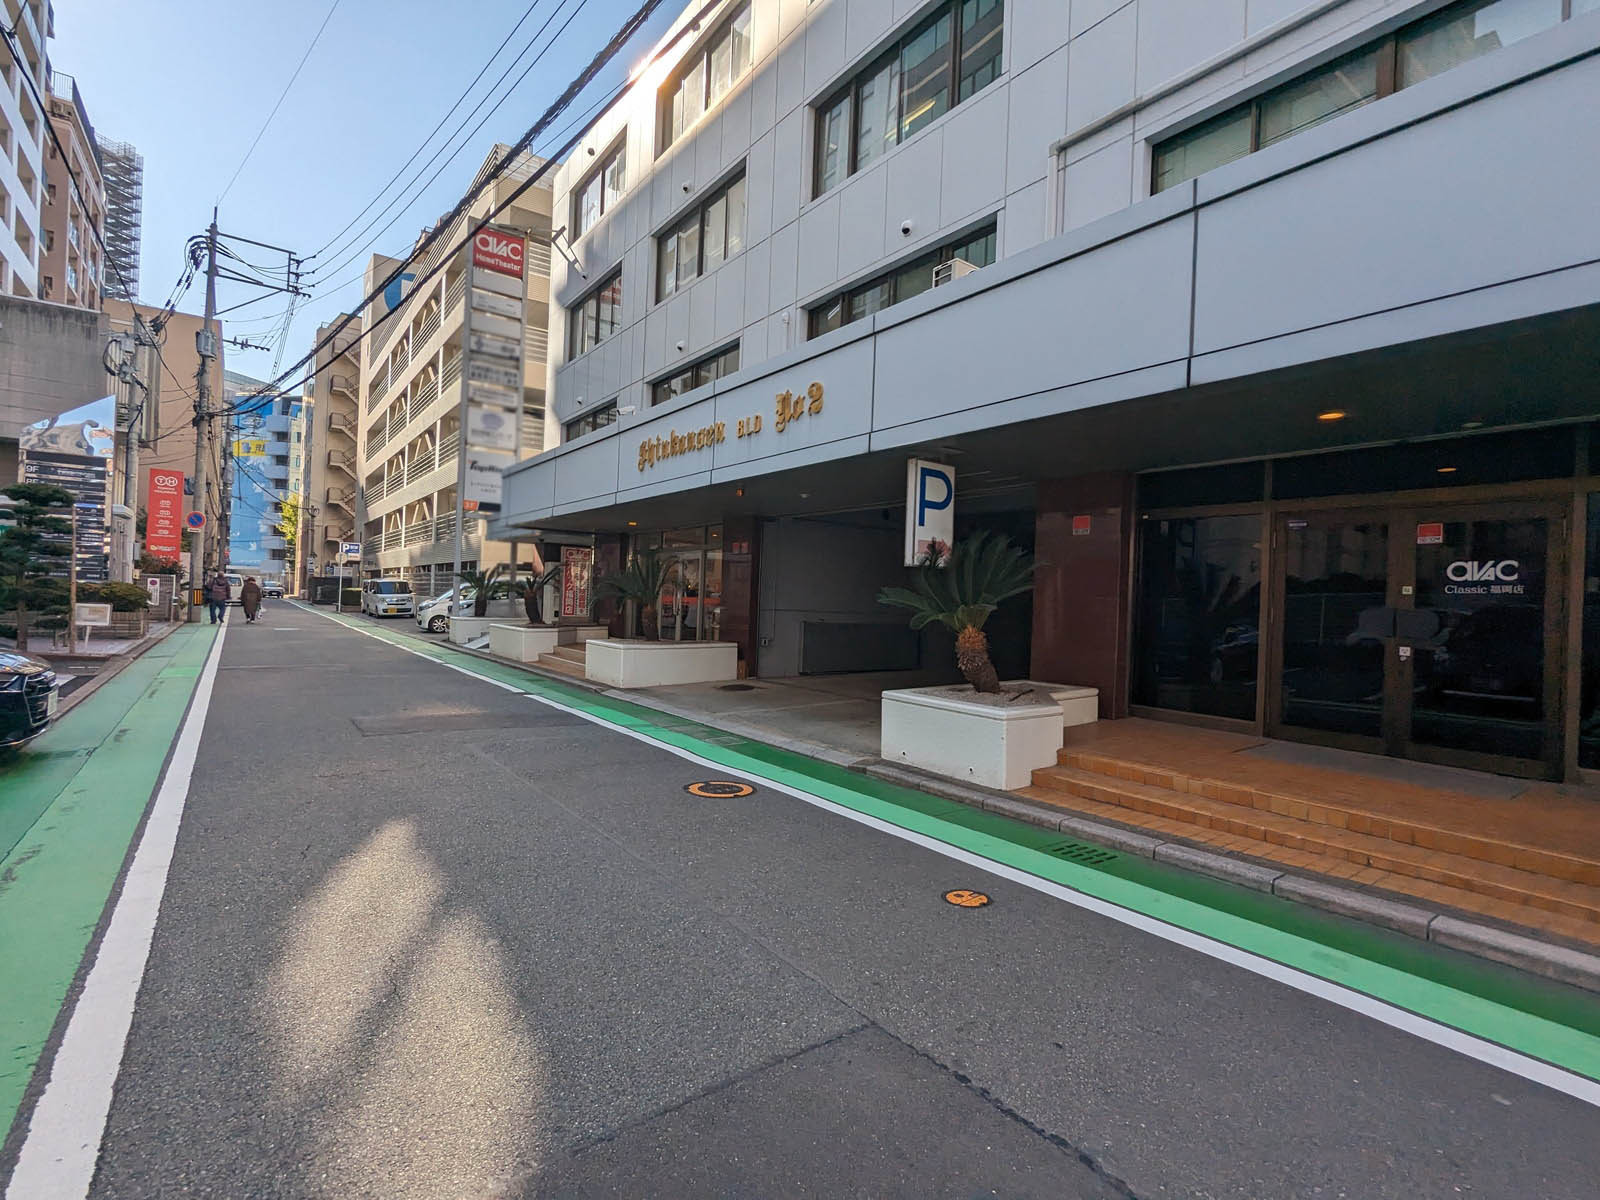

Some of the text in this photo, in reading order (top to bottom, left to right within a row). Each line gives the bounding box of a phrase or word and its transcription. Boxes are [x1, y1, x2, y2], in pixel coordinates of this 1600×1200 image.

[26, 464, 40, 473] 9F
[918, 466, 953, 527] P
[343, 544, 350, 552] P
[1444, 584, 1525, 594] Classic 福岡店
